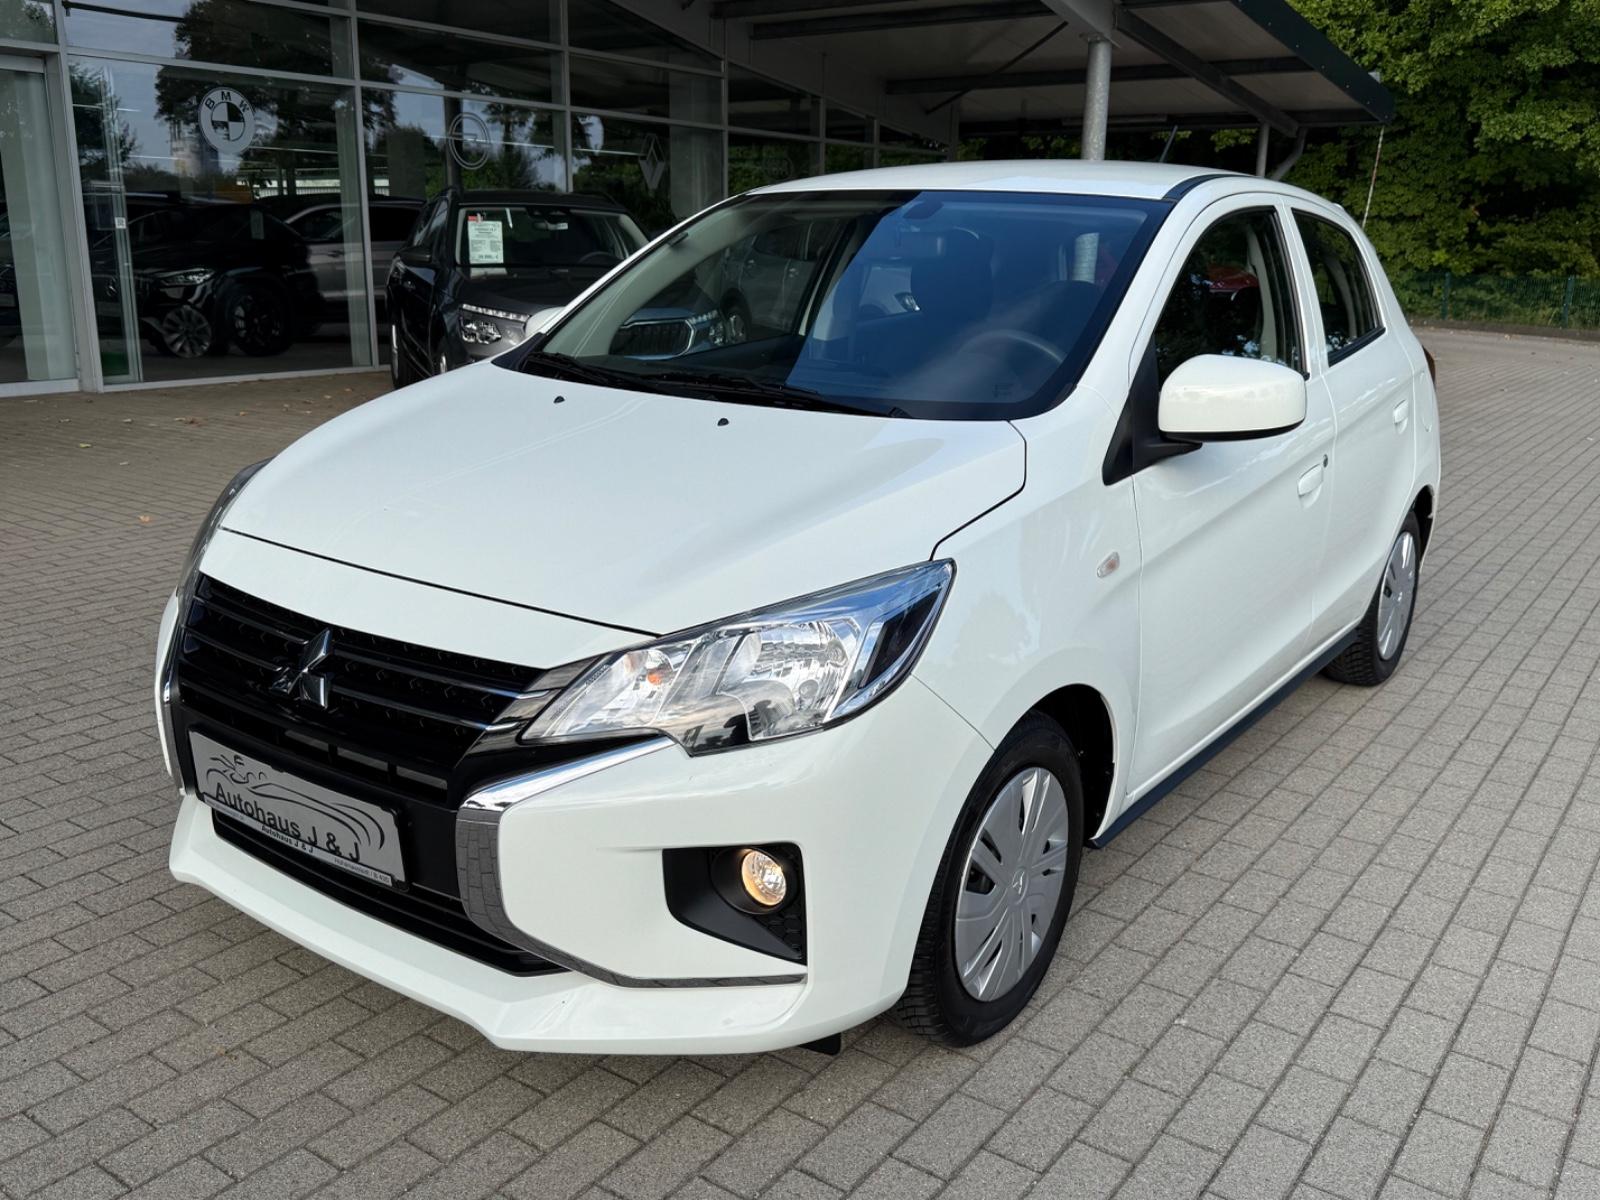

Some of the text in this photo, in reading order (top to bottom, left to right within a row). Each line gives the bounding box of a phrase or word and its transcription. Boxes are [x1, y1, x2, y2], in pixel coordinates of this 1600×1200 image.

[204, 91, 251, 112] BMW
[215, 782, 301, 840] Autohaus
[307, 826, 318, 846] J
[325, 832, 342, 857] &
[348, 842, 360, 863] J
[261, 825, 293, 845] Autohaus
[301, 844, 307, 852] &
[308, 846, 314, 854] J
